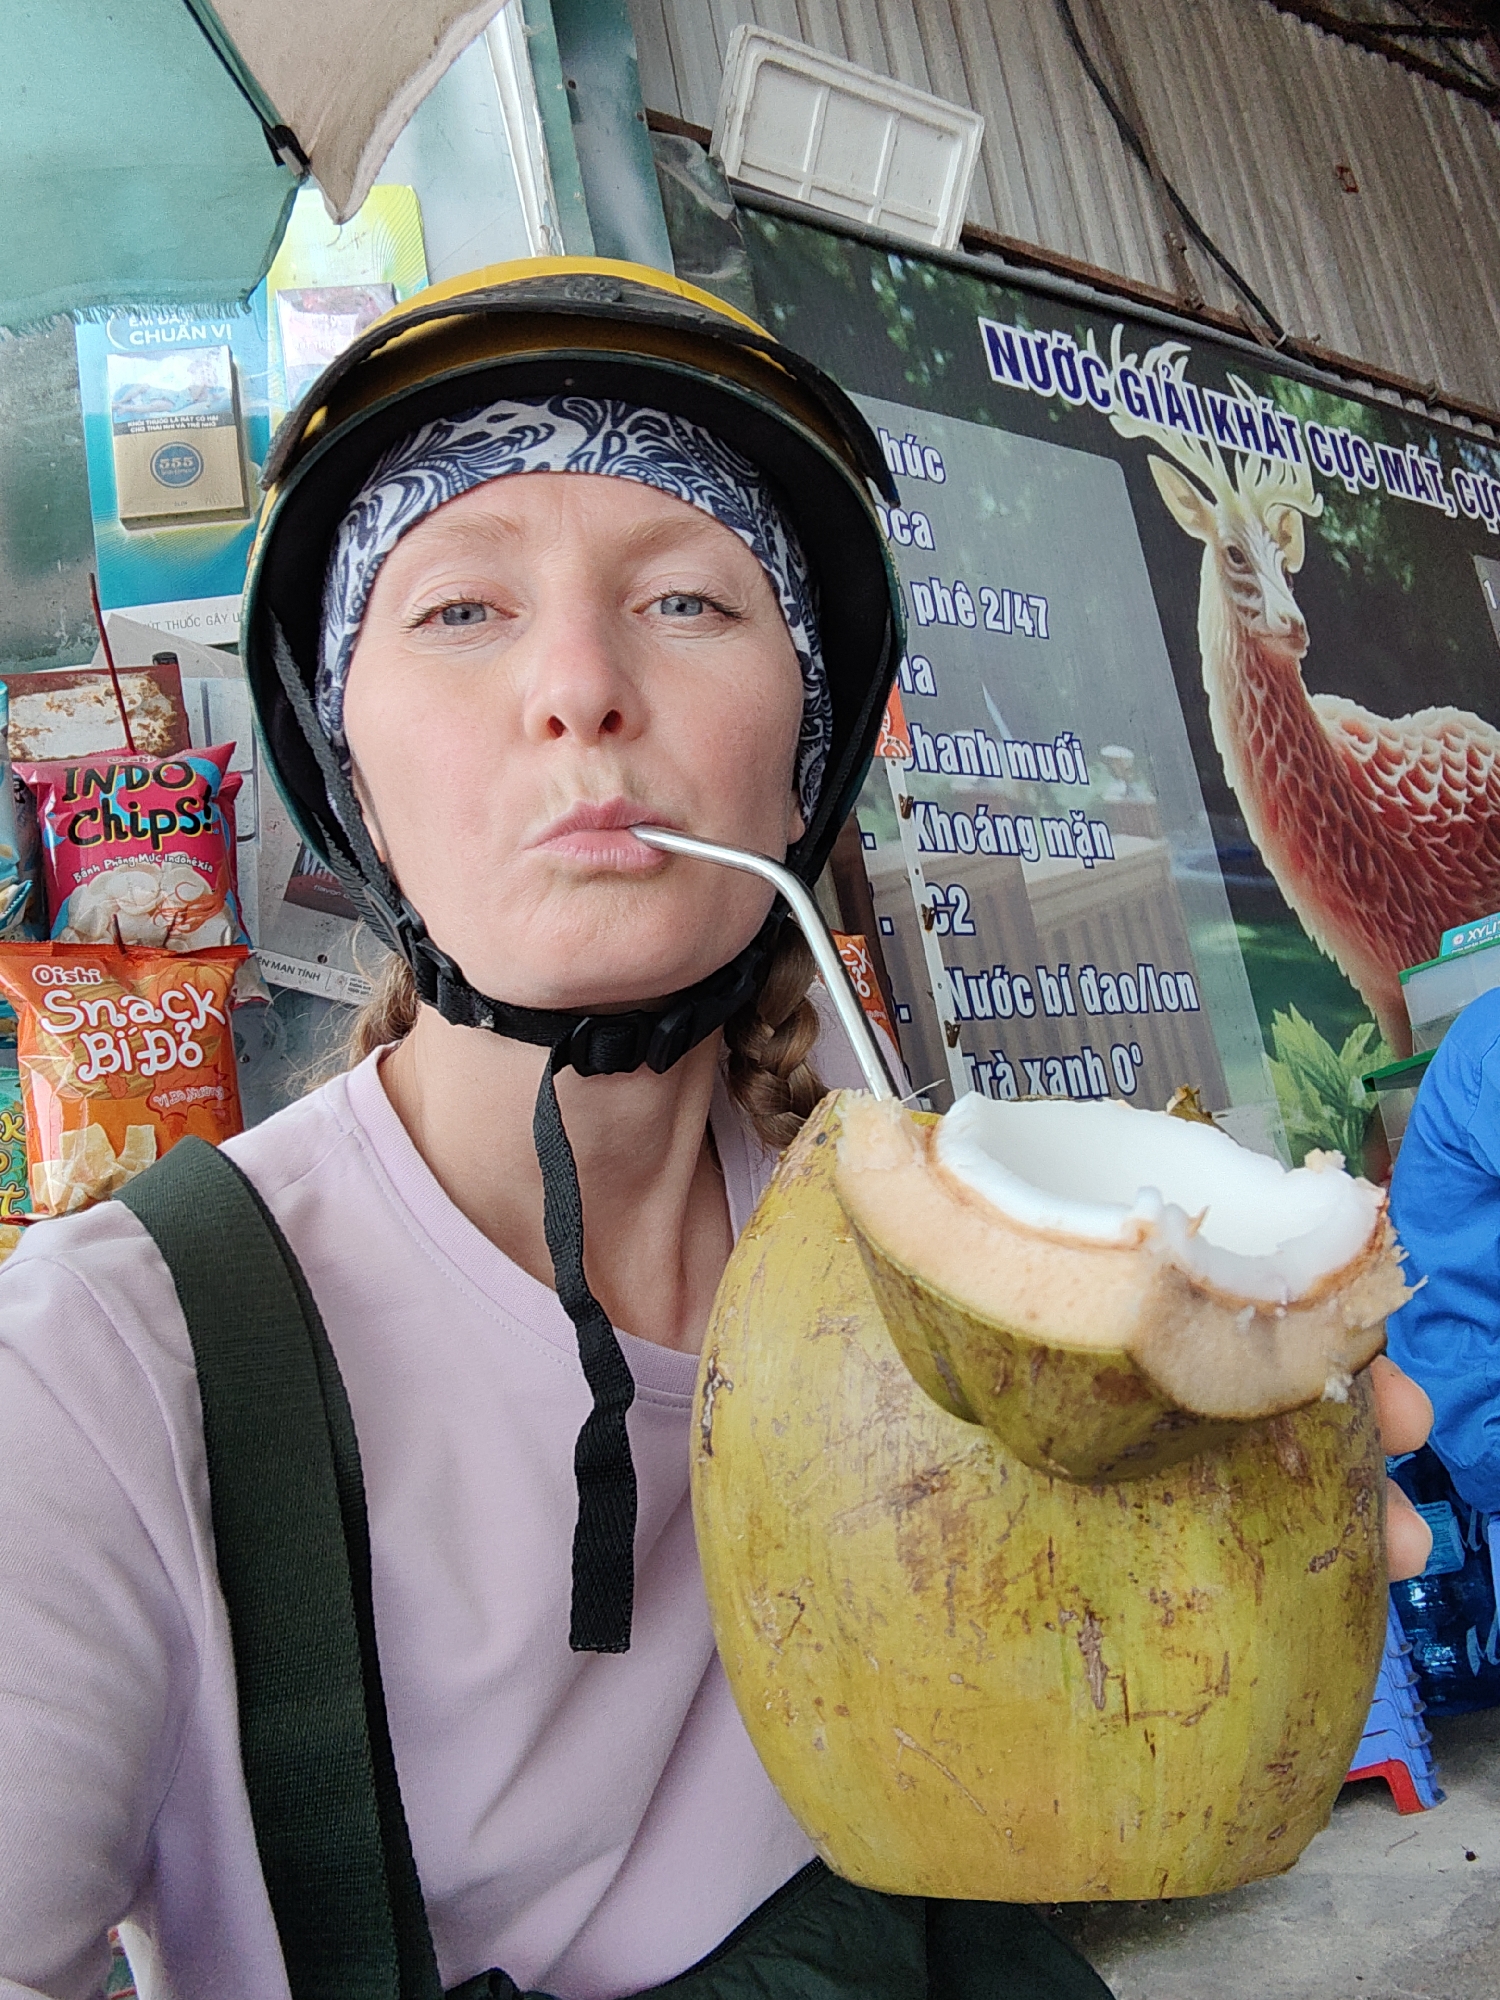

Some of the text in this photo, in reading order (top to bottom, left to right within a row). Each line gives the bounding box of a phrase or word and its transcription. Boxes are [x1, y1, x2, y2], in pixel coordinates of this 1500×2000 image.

[212, 324, 232, 341] VỊ
[979, 319, 1115, 412] NƯỚC
[1117, 360, 1207, 439] GIẢI
[1205, 390, 1302, 465] KHÁT
[1305, 421, 1379, 494] CỰC
[1375, 443, 1458, 517] MÁT,
[159, 456, 195, 470] 555
[165, 613, 201, 630] THUỐC
[205, 612, 228, 626] GÂY
[910, 576, 977, 629] phê
[905, 722, 1090, 785] hanh muối
[62, 760, 196, 803] INDO
[67, 784, 213, 852] Chips!
[913, 801, 1116, 870] Khoáng mặn
[924, 882, 977, 937] C2
[32, 964, 103, 986] Oishi
[297, 967, 321, 982] TÍNH
[944, 962, 1201, 1021] Nước bí đao/lon
[39, 982, 226, 1034] Snack
[77, 1021, 204, 1083] Bí Đỏ
[962, 1050, 1019, 1101] Trà
[1020, 1045, 1112, 1100] xanh
